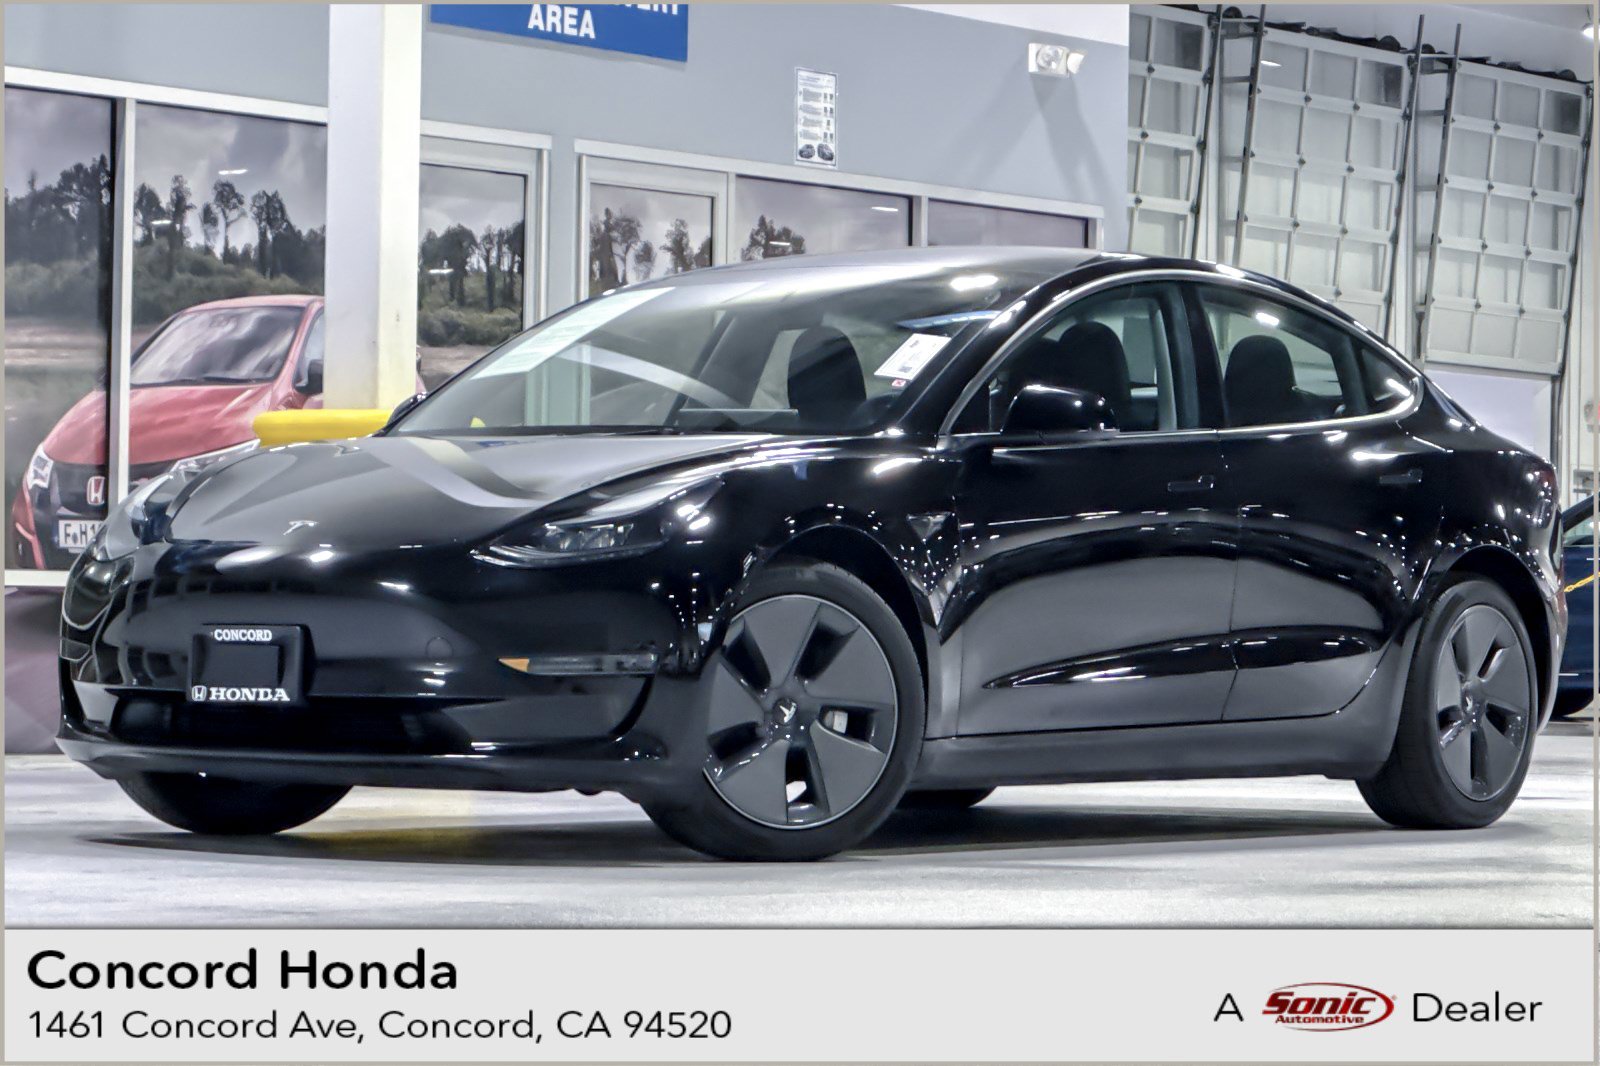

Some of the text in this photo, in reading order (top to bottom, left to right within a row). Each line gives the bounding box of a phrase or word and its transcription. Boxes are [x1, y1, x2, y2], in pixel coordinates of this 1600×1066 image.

[528, 4, 595, 39] AREA
[214, 629, 273, 642] CONCORD
[209, 687, 291, 702] HONDA
